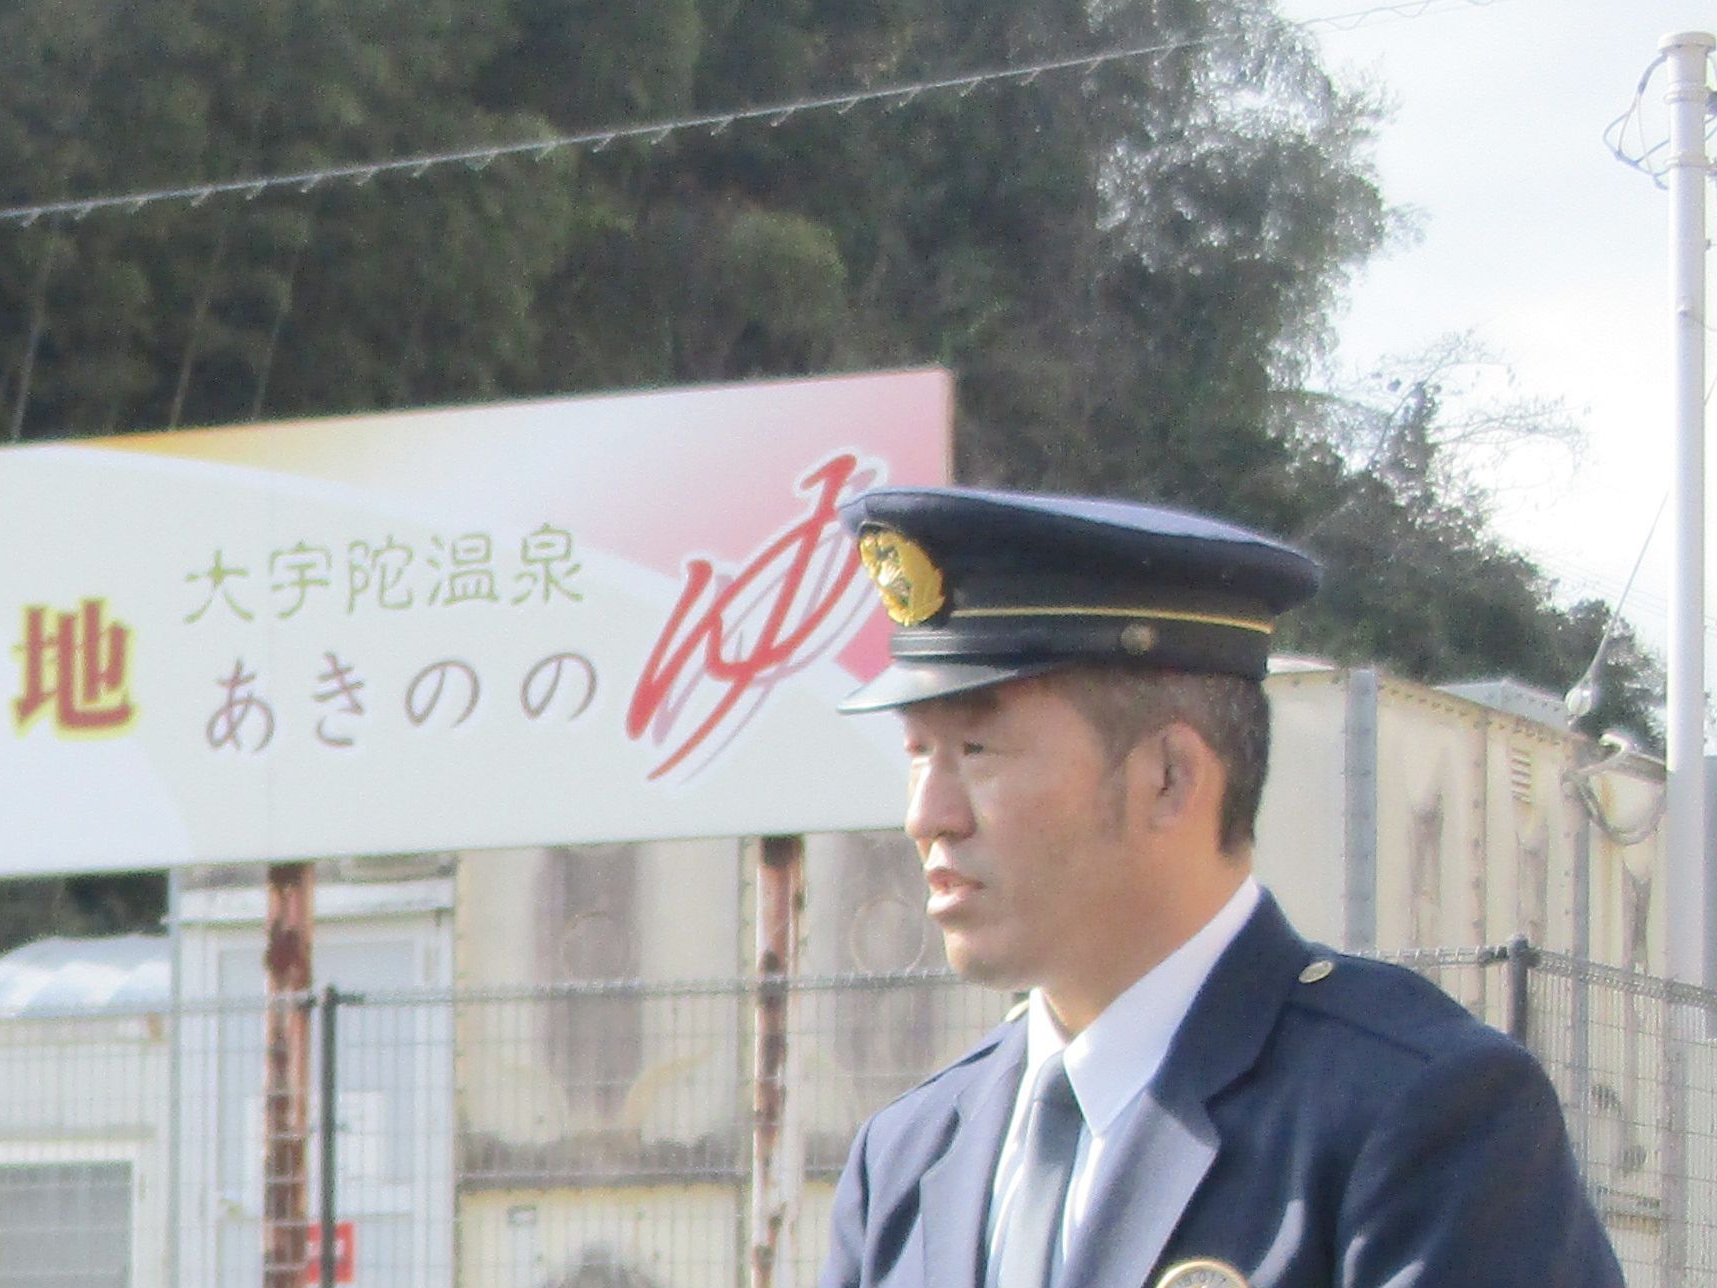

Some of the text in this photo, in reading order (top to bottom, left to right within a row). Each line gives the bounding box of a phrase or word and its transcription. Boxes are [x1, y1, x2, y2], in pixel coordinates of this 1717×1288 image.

[183, 522, 584, 623] 大宇陀温泉
